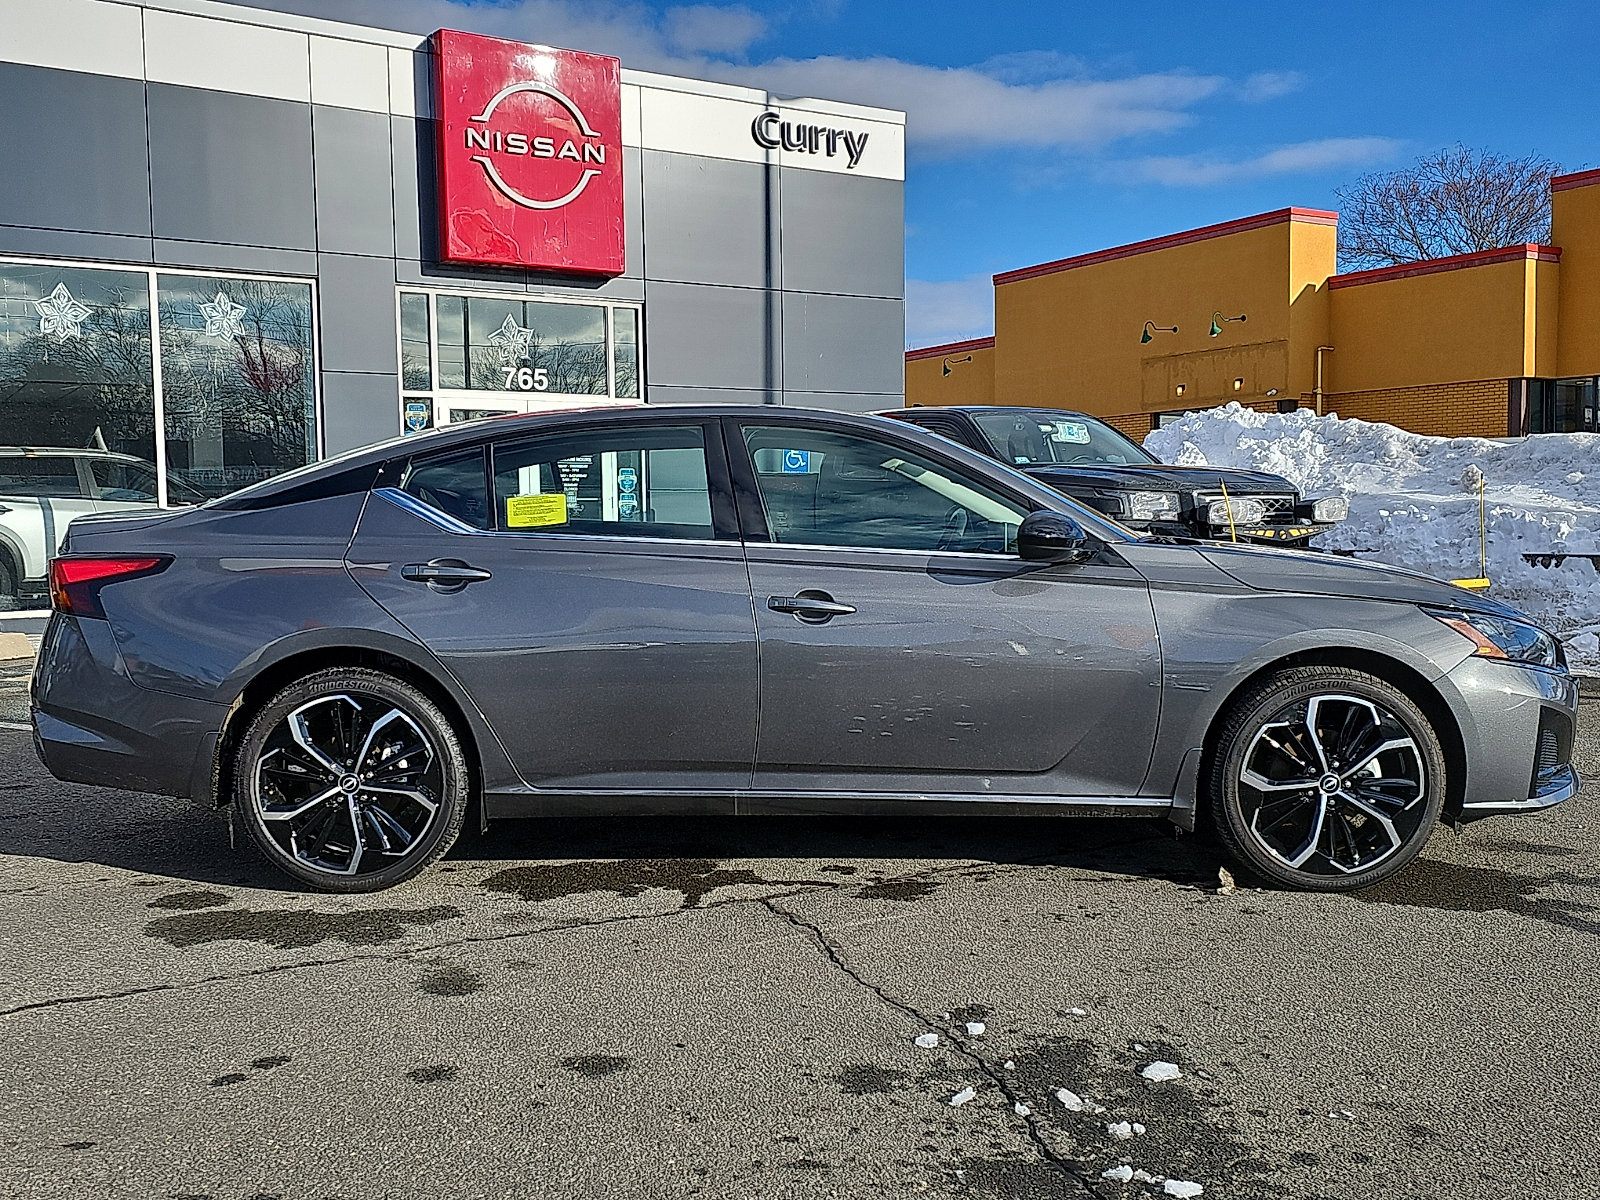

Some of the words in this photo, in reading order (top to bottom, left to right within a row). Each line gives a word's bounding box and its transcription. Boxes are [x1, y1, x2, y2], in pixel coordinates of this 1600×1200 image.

[465, 127, 606, 164] NISSAN
[751, 111, 870, 169] Curry
[501, 366, 549, 391] 765
[308, 680, 383, 694] BRIDGESTONE
[1282, 680, 1354, 700] BRIDGESTONE
